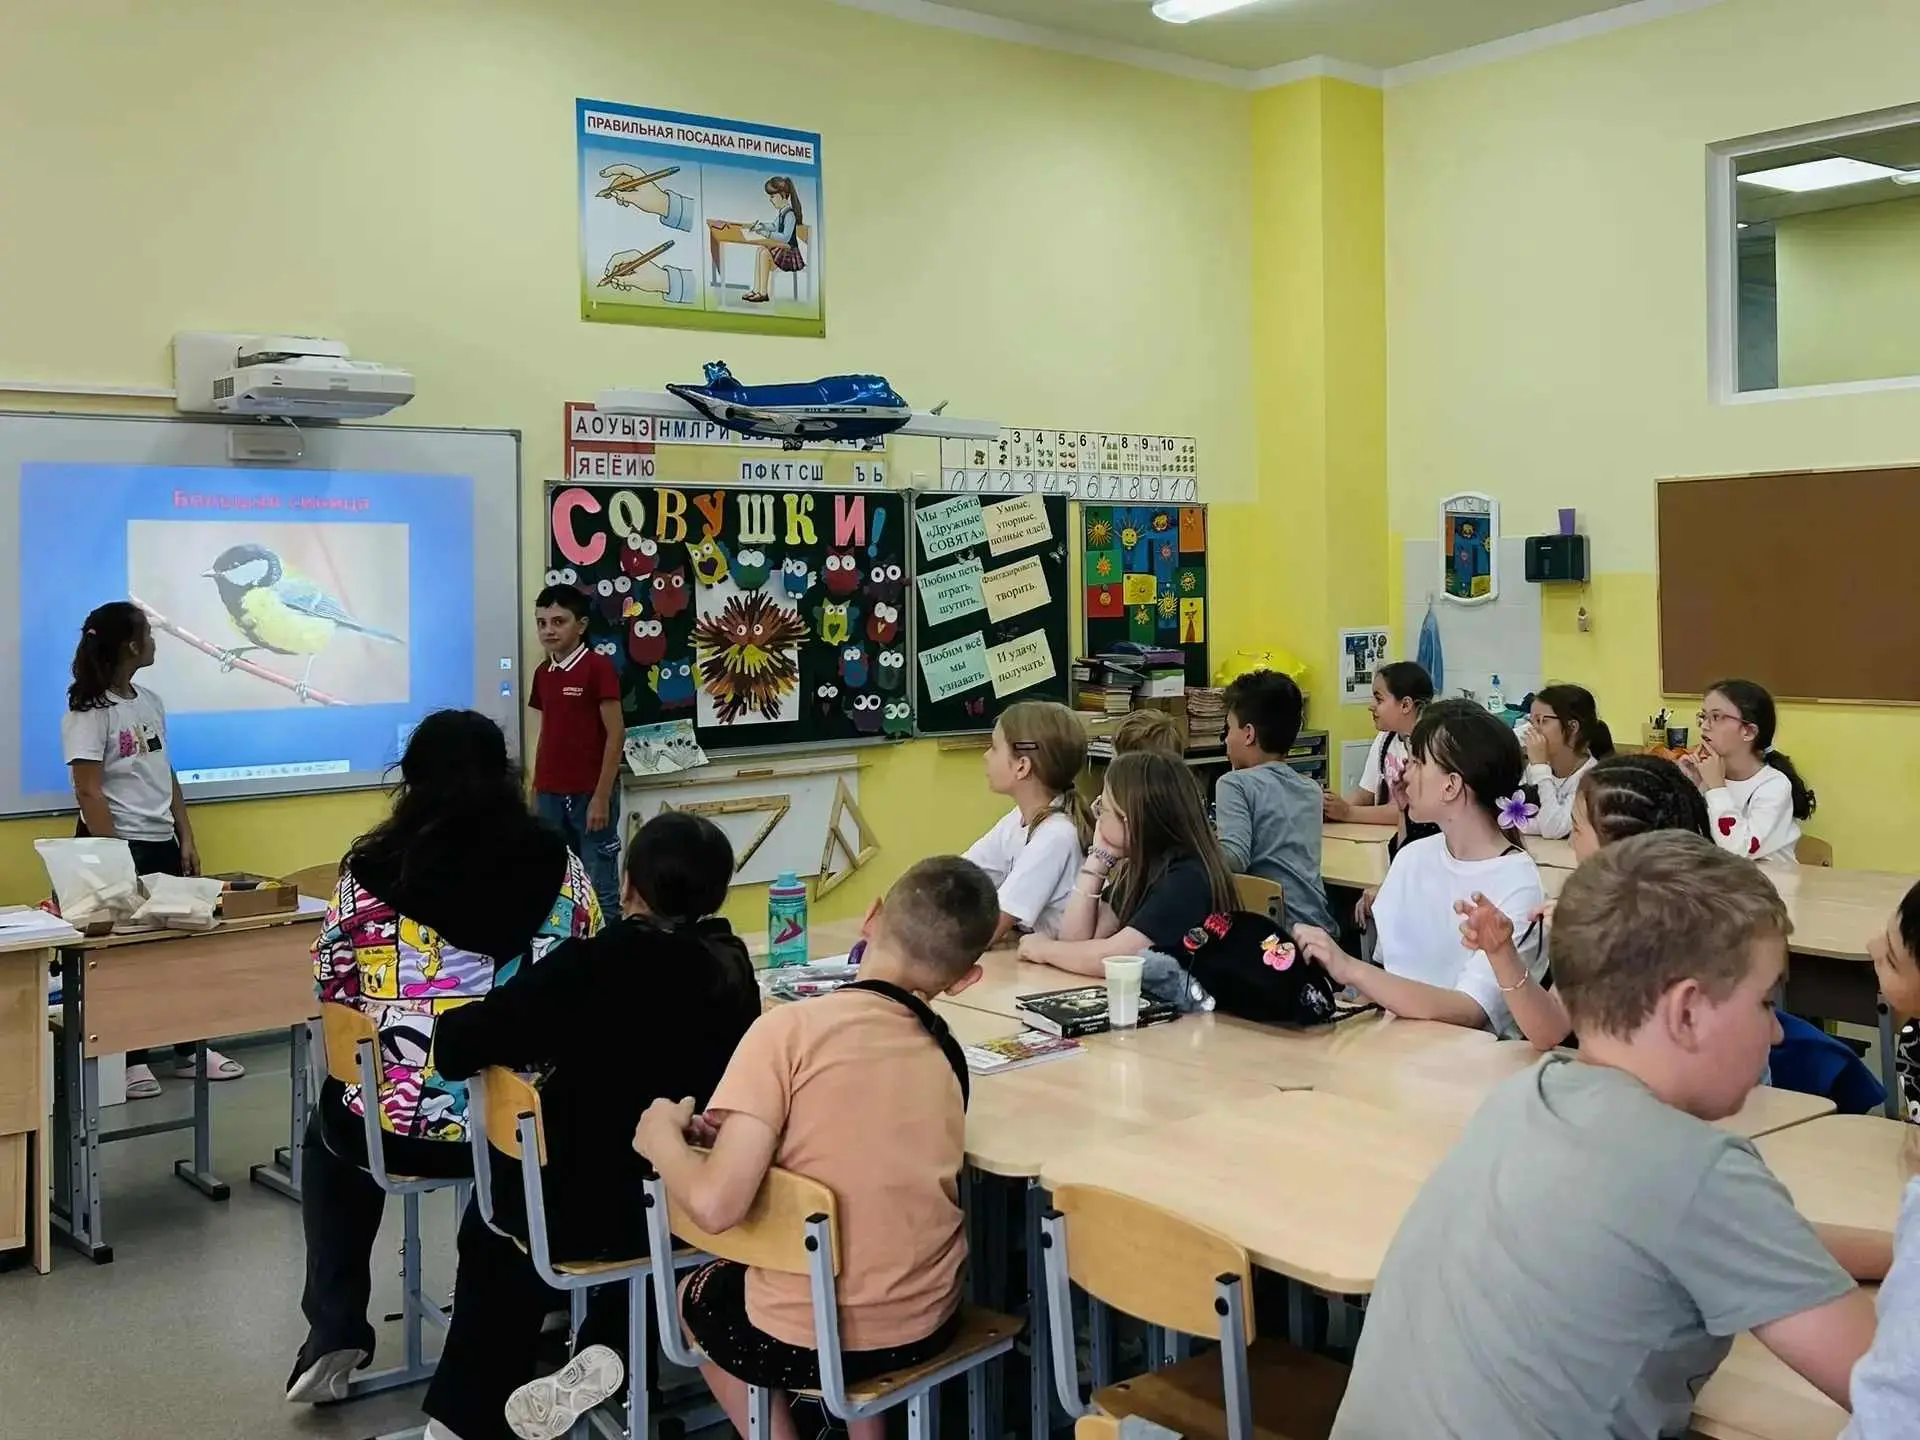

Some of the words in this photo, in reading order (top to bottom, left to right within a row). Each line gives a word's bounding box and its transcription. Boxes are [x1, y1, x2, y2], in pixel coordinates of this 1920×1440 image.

[587, 116, 673, 139] ПРАВИЛЬНАЯ
[677, 128, 735, 149] ПОСАДКА
[738, 137, 761, 152] ПРИ
[764, 141, 811, 159] ПИСЬМЕ
[1014, 431, 1021, 443] 3
[1036, 432, 1043, 444] 4
[1058, 433, 1066, 445] 5
[1080, 434, 1087, 446] 6
[1101, 436, 1107, 447] 7
[1121, 437, 1128, 448] 8
[1142, 438, 1149, 449] 9
[1161, 439, 1174, 451] 10
[1066, 475, 1077, 497] 5
[1087, 475, 1098, 498] 6
[1109, 476, 1119, 498] 7
[1129, 476, 1139, 499] 8
[1149, 477, 1160, 500] 9
[916, 511, 938, 523] Мы
[929, 529, 985, 554] СОВЯТА»
[990, 531, 1024, 546] полные
[1027, 523, 1047, 536] идей
[920, 571, 957, 590] Любим
[925, 645, 963, 666] Любим
[996, 651, 1006, 663] И
[1008, 641, 1038, 662] удачу
[949, 660, 967, 673] мы
[998, 654, 1047, 683] получать!
[938, 671, 985, 697] узнавать
